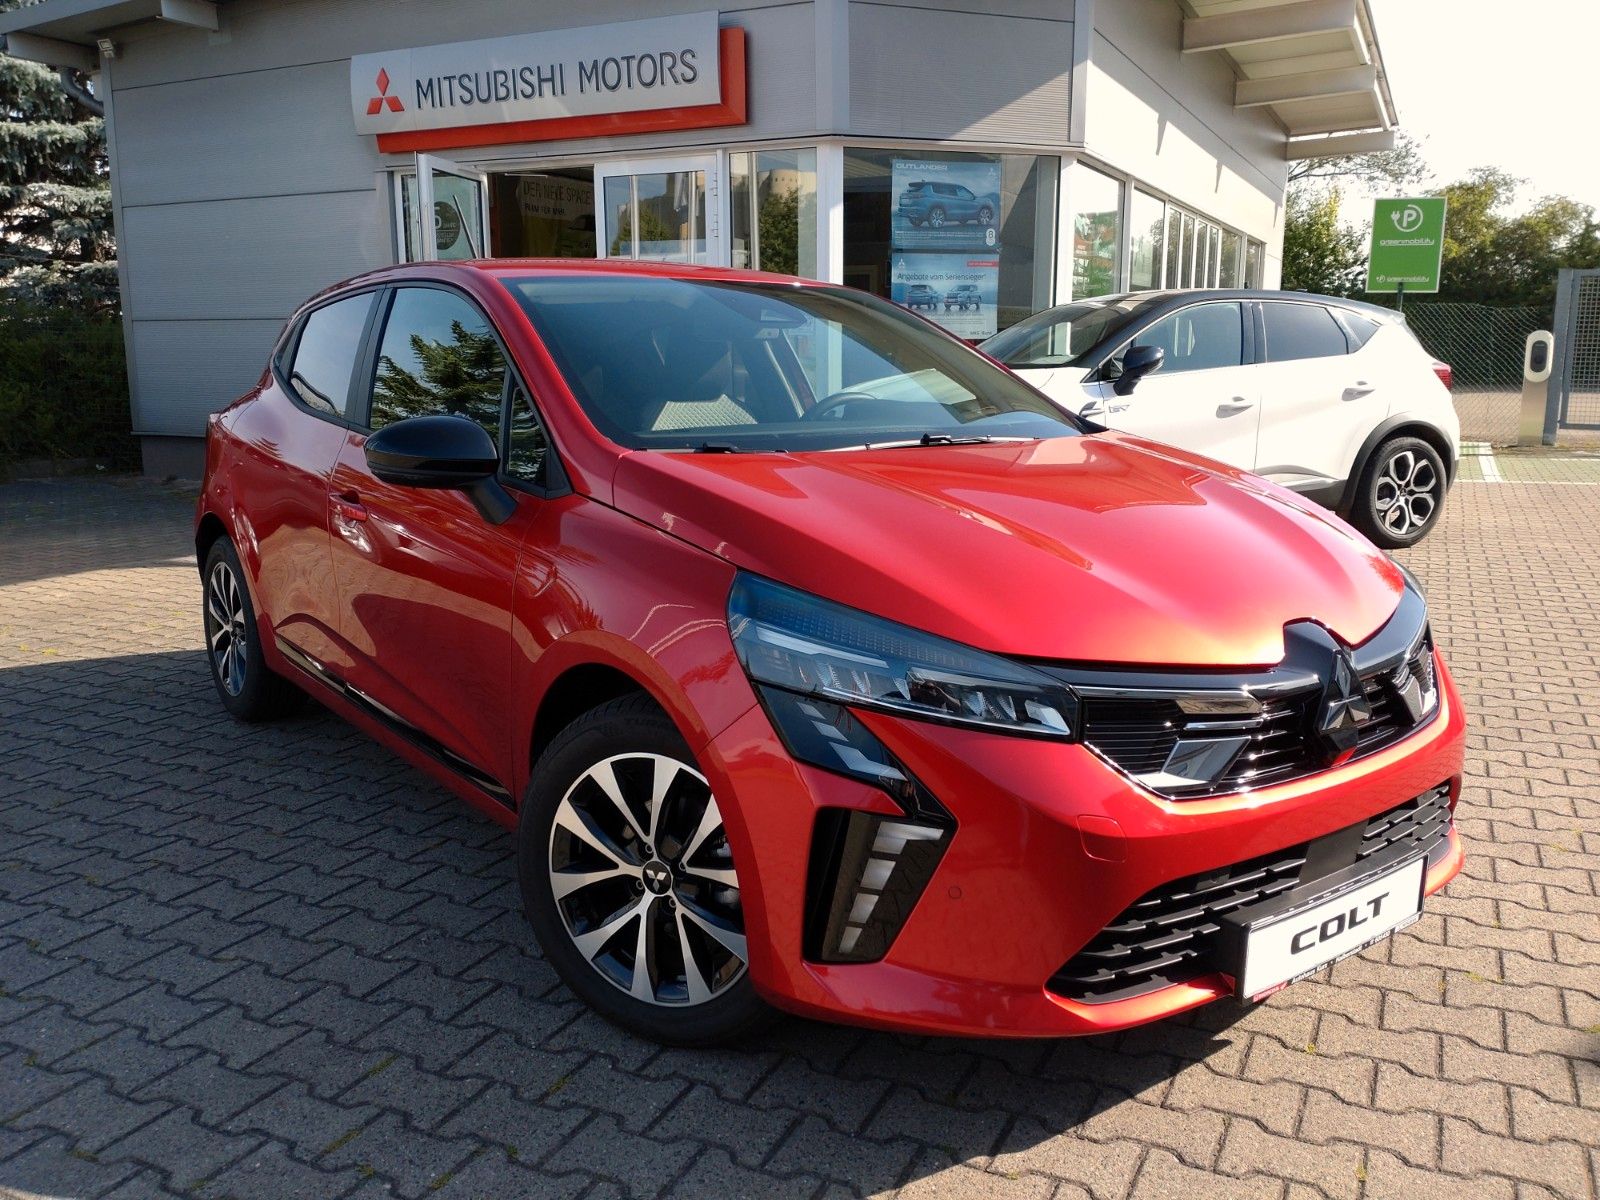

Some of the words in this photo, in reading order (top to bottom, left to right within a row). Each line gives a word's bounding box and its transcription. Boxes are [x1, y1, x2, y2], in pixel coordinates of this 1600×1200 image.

[415, 63, 567, 109] MITSUBISHI
[578, 48, 698, 93] MOTORS
[896, 163, 948, 171] OUTLANDER
[1380, 238, 1434, 246] greenmobility
[897, 273, 929, 282] Angebote
[1291, 892, 1390, 955] COLT
